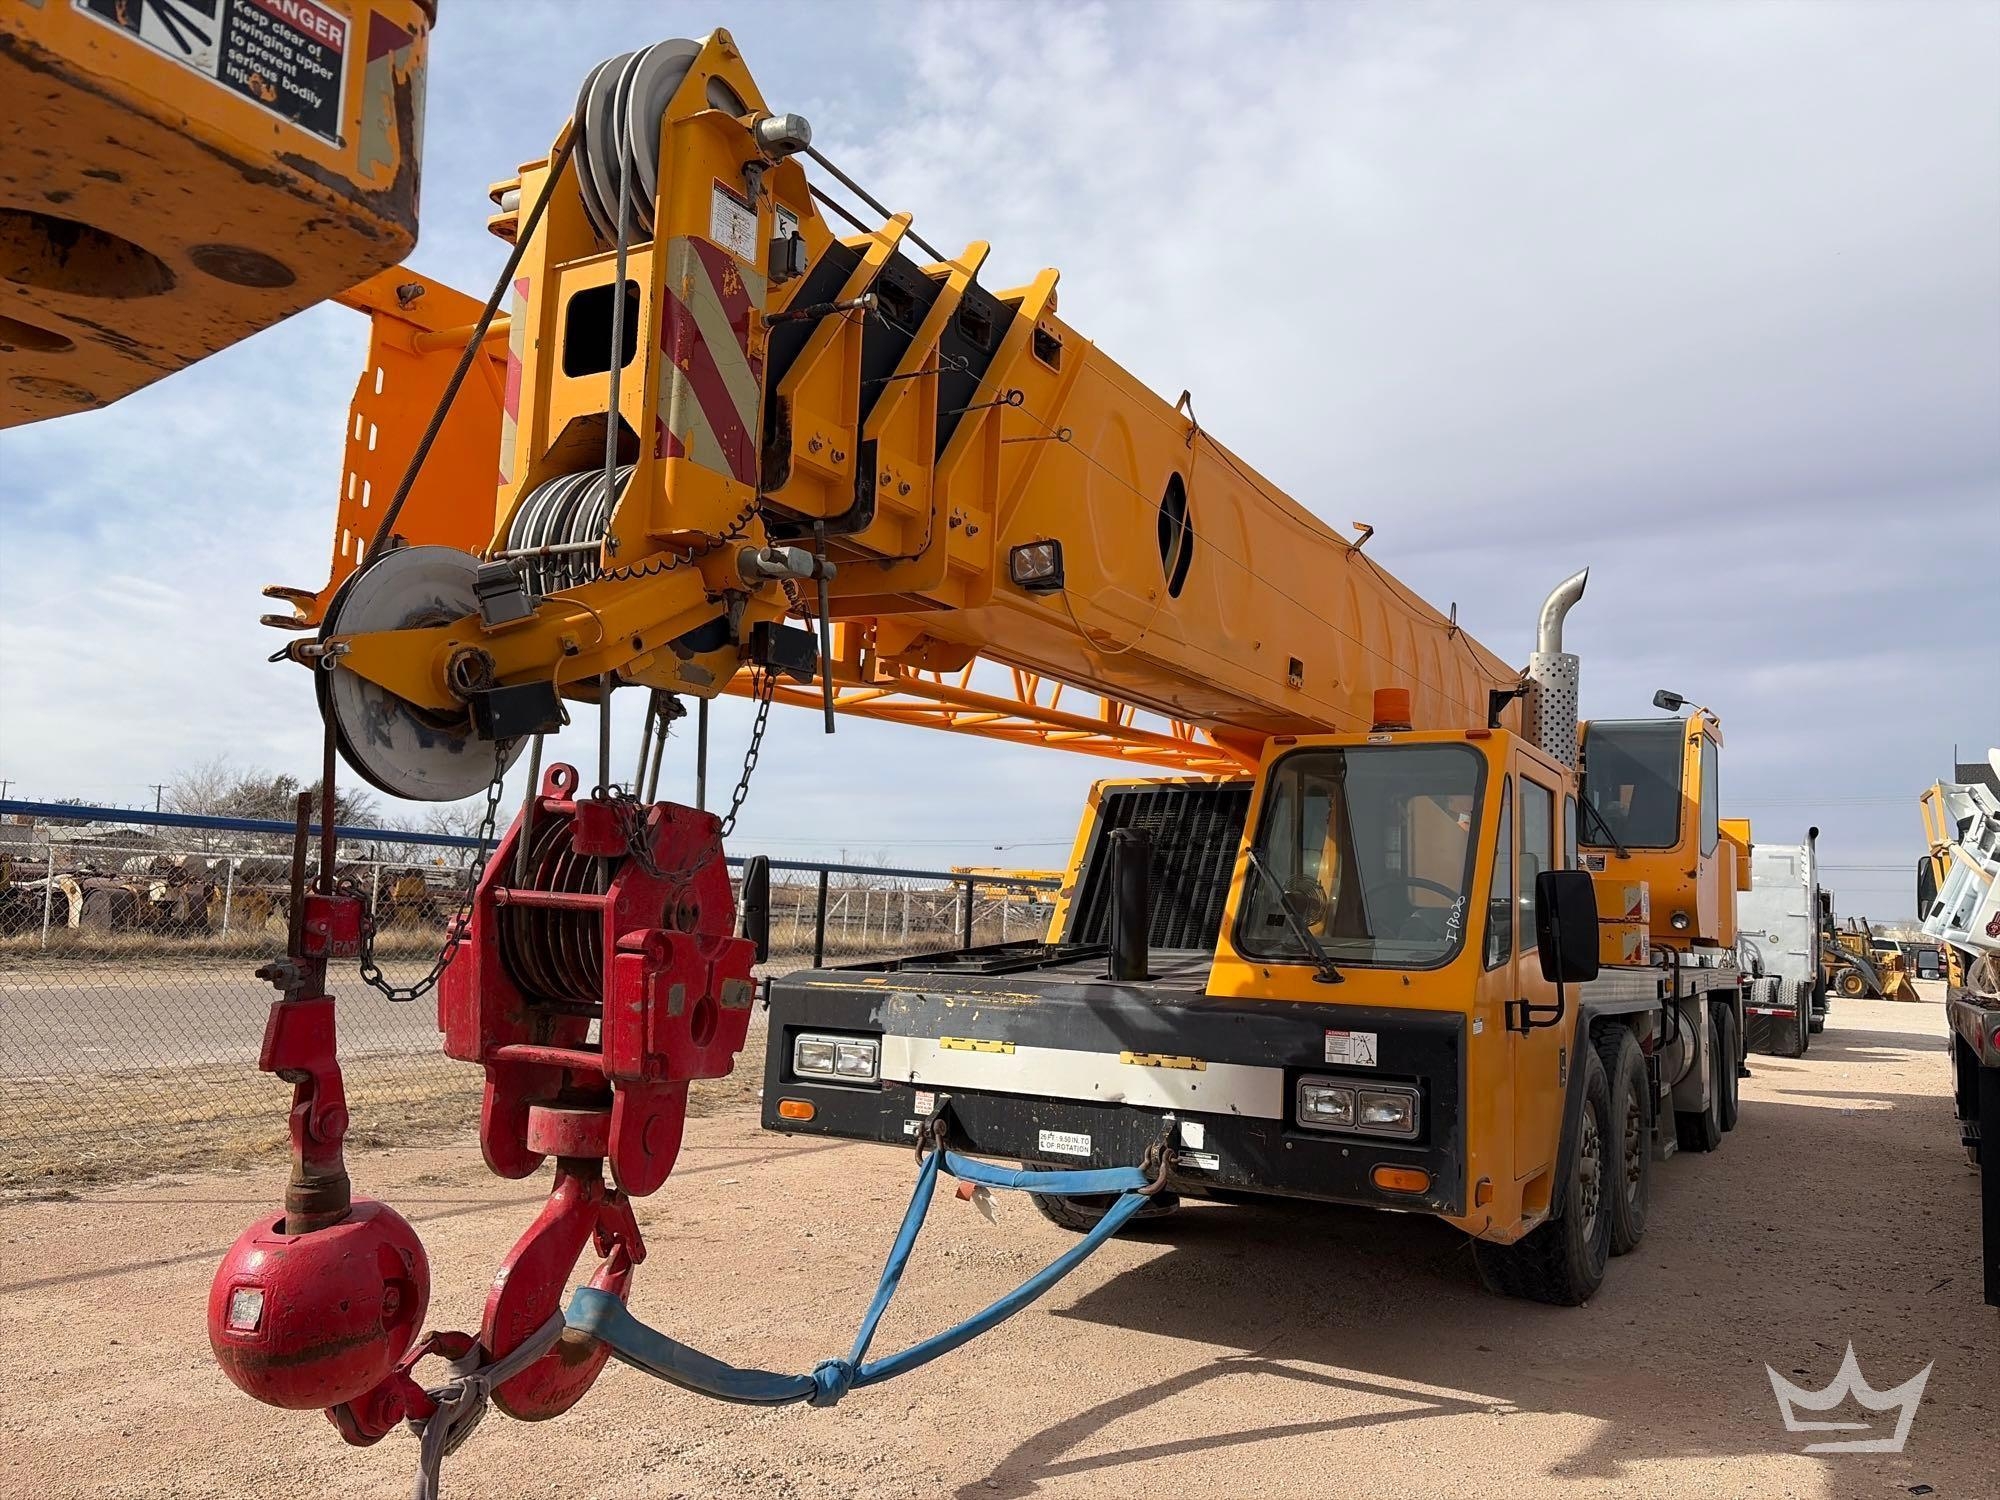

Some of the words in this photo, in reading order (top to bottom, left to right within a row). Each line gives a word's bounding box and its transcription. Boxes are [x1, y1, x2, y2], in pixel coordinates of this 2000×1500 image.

[233, 0, 269, 27] Keep
[272, 22, 304, 48] clear
[307, 43, 322, 57] of
[257, 0, 342, 47] ANGER
[230, 30, 246, 47] to
[246, 42, 297, 77] prevent
[232, 16, 293, 60] swinging
[295, 53, 334, 81] upper
[228, 48, 279, 83] serious
[281, 76, 322, 108] bodily
[1056, 1143, 1089, 1153] ROTATION
[1080, 1137, 1089, 1145] TO
